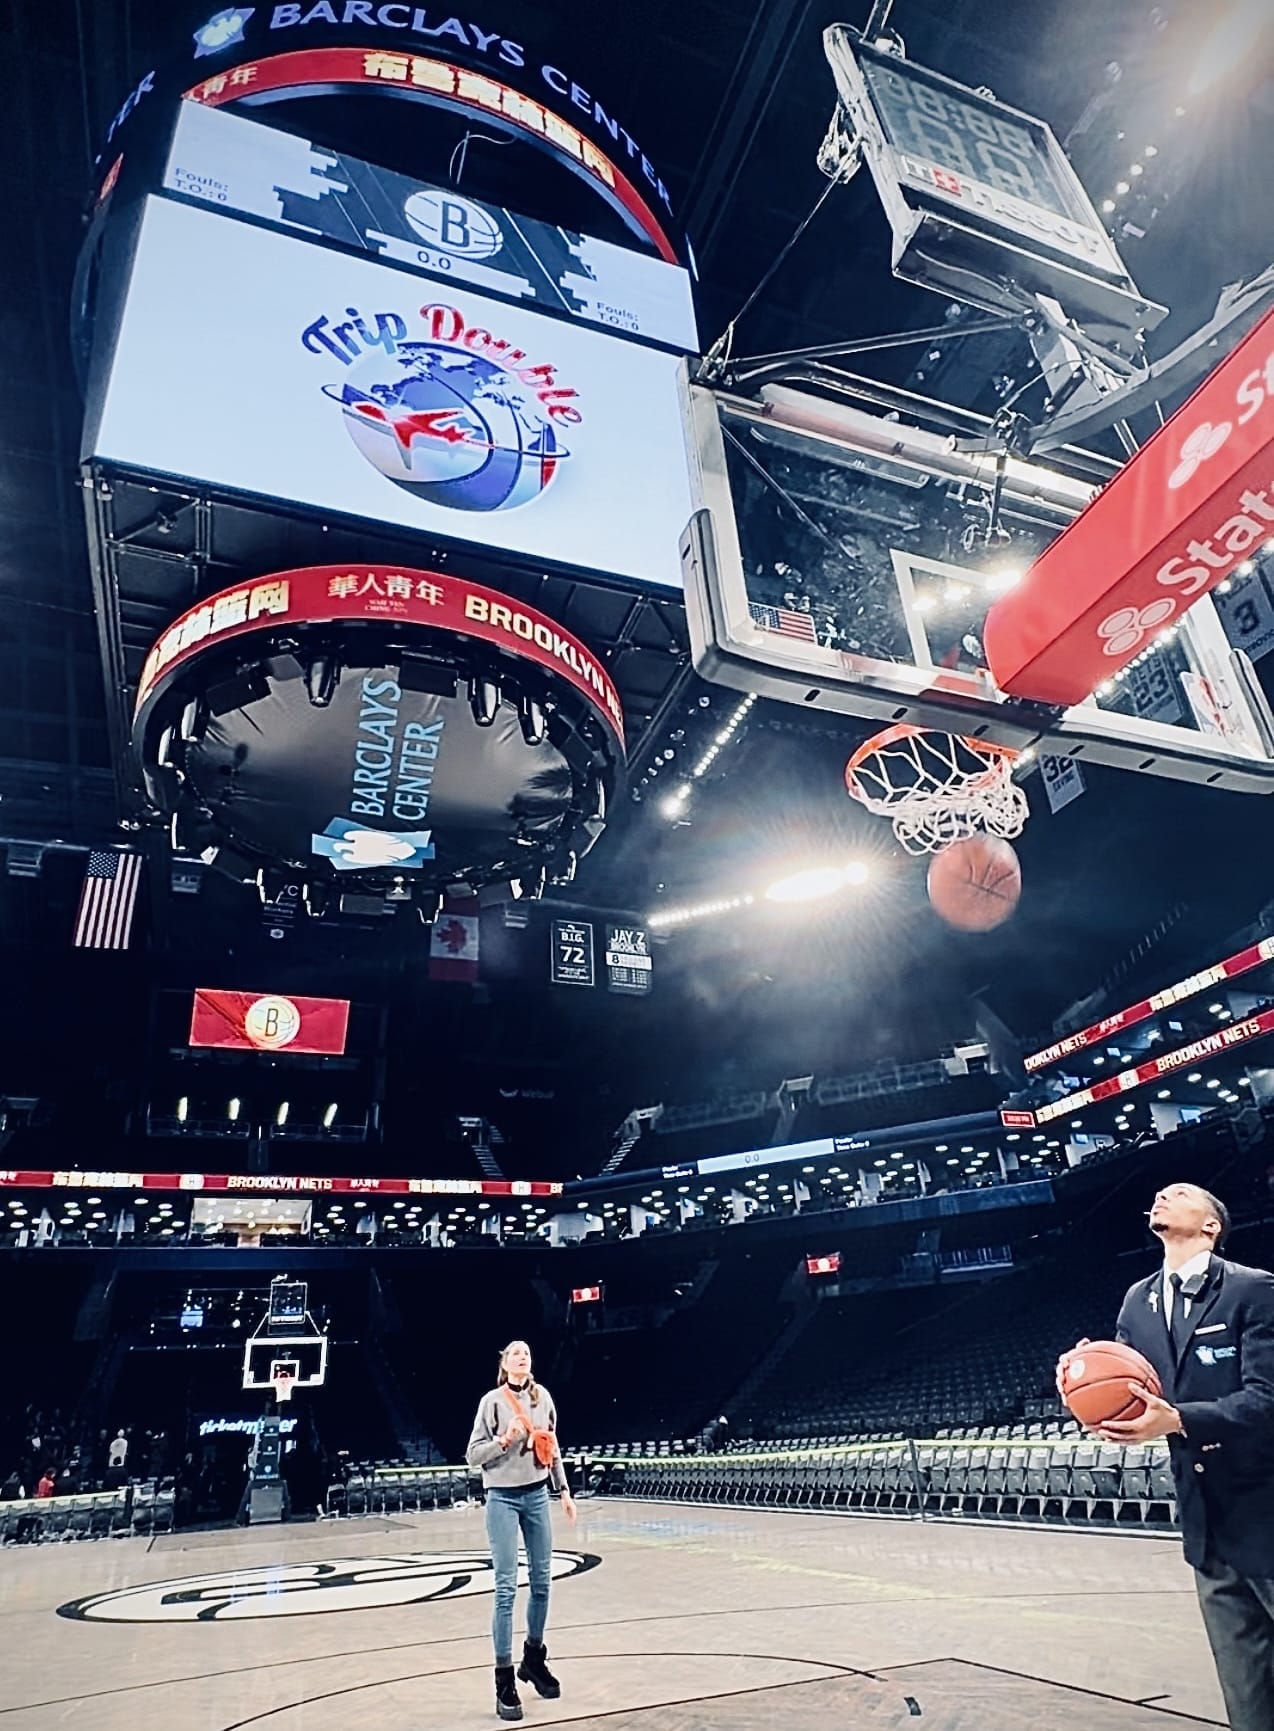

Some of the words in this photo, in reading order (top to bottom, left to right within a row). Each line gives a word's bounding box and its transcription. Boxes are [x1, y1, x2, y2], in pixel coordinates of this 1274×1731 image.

[269, 0, 525, 67] BARCLAYS
[541, 64, 674, 217] CENTER
[175, 167, 229, 192] Fouls:
[441, 201, 469, 248] B
[417, 250, 452, 271] 0.0
[596, 301, 640, 322] Fouls:
[301, 306, 408, 366] Trip
[419, 302, 584, 428] Double
[1156, 481, 1274, 597] Stat
[327, 572, 446, 606] 華人青年
[465, 594, 605, 698] BROOKLYN
[1133, 667, 1170, 713] 23
[351, 677, 402, 817] BARCLAYS
[392, 719, 446, 822] CENTER
[610, 928, 634, 943] JAY
[636, 931, 646, 945] Z
[560, 945, 586, 964] 72
[611, 954, 620, 965] 8
[264, 1007, 281, 1037] B
[1060, 1031, 1087, 1054] NETS
[1156, 1032, 1223, 1072] BROOKLYN
[1221, 1018, 1261, 1046] NETS
[227, 1175, 298, 1191] BROOKLYN
[299, 1177, 333, 1191] NETS
